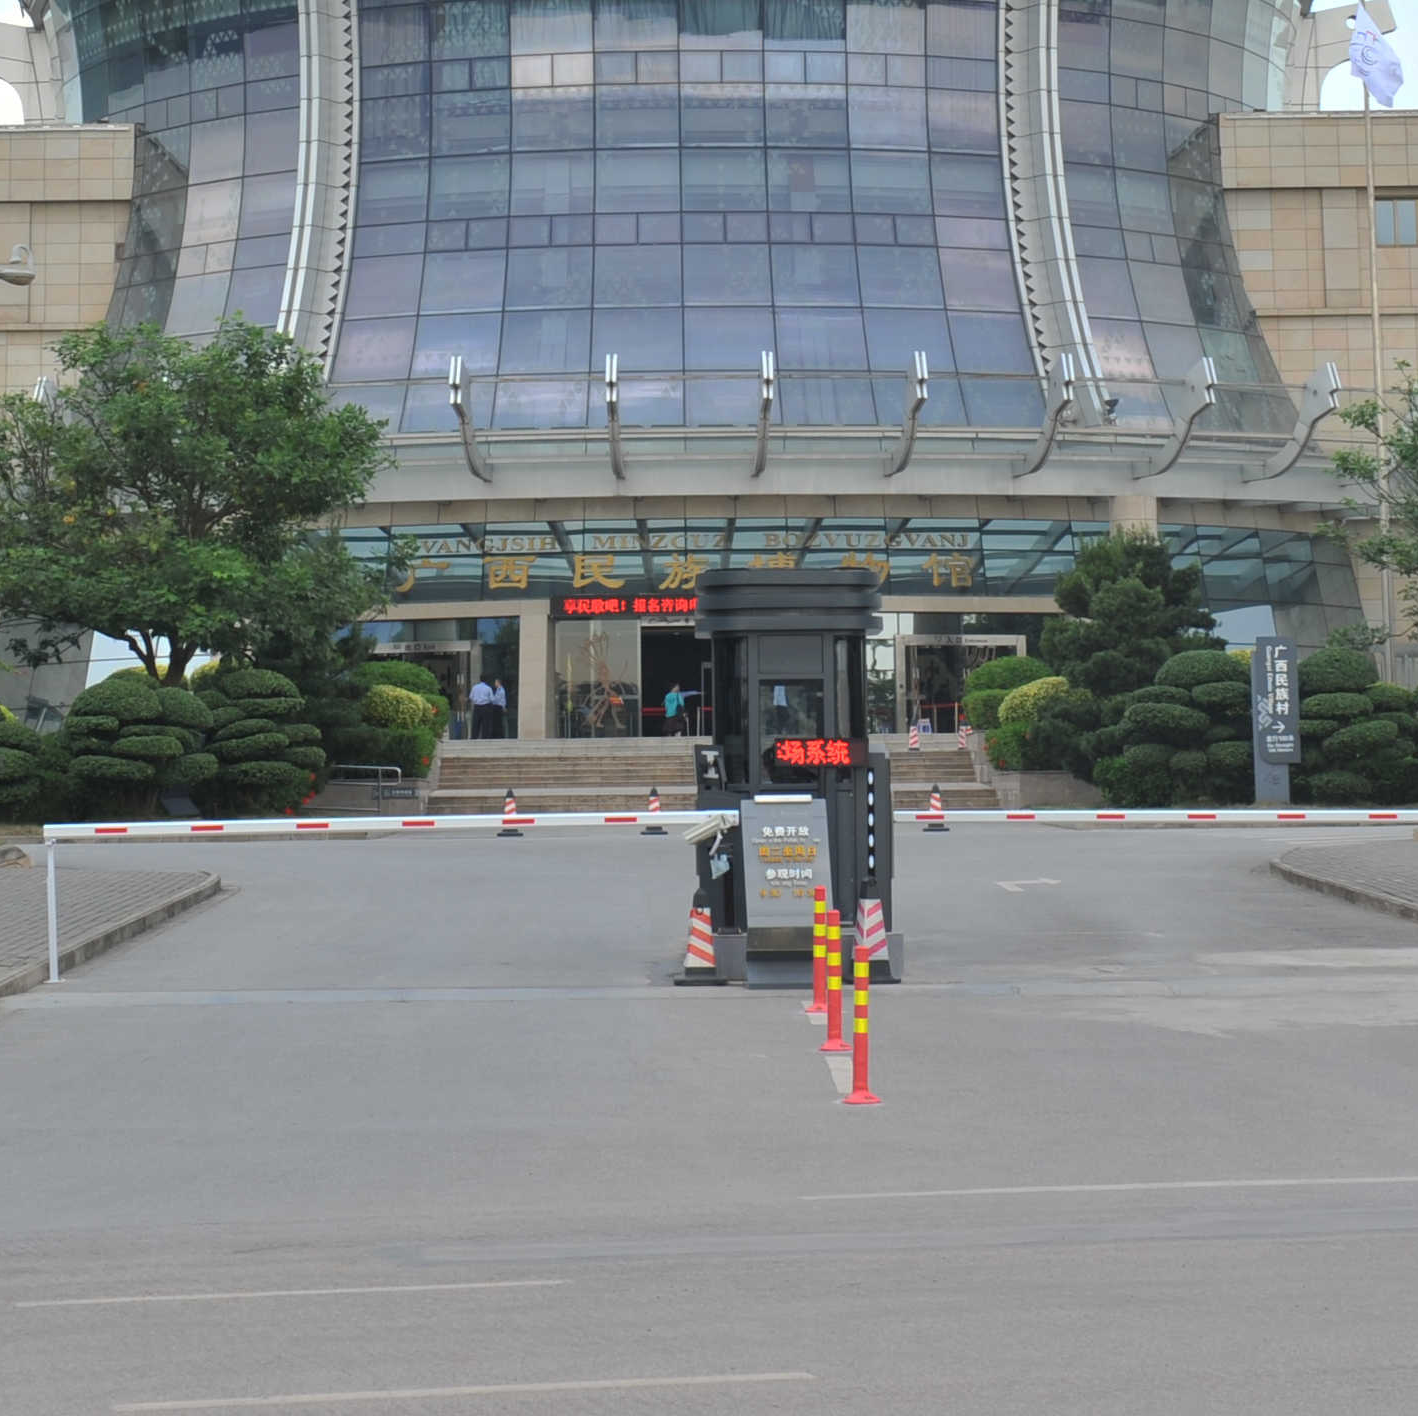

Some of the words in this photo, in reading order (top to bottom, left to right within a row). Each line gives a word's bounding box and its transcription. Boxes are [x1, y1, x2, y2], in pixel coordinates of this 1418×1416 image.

[419, 535, 558, 553] VANGJSIH
[1273, 644, 1289, 715] 广西民族村
[776, 737, 852, 766] 场系统
[762, 825, 810, 837] 免费开放
